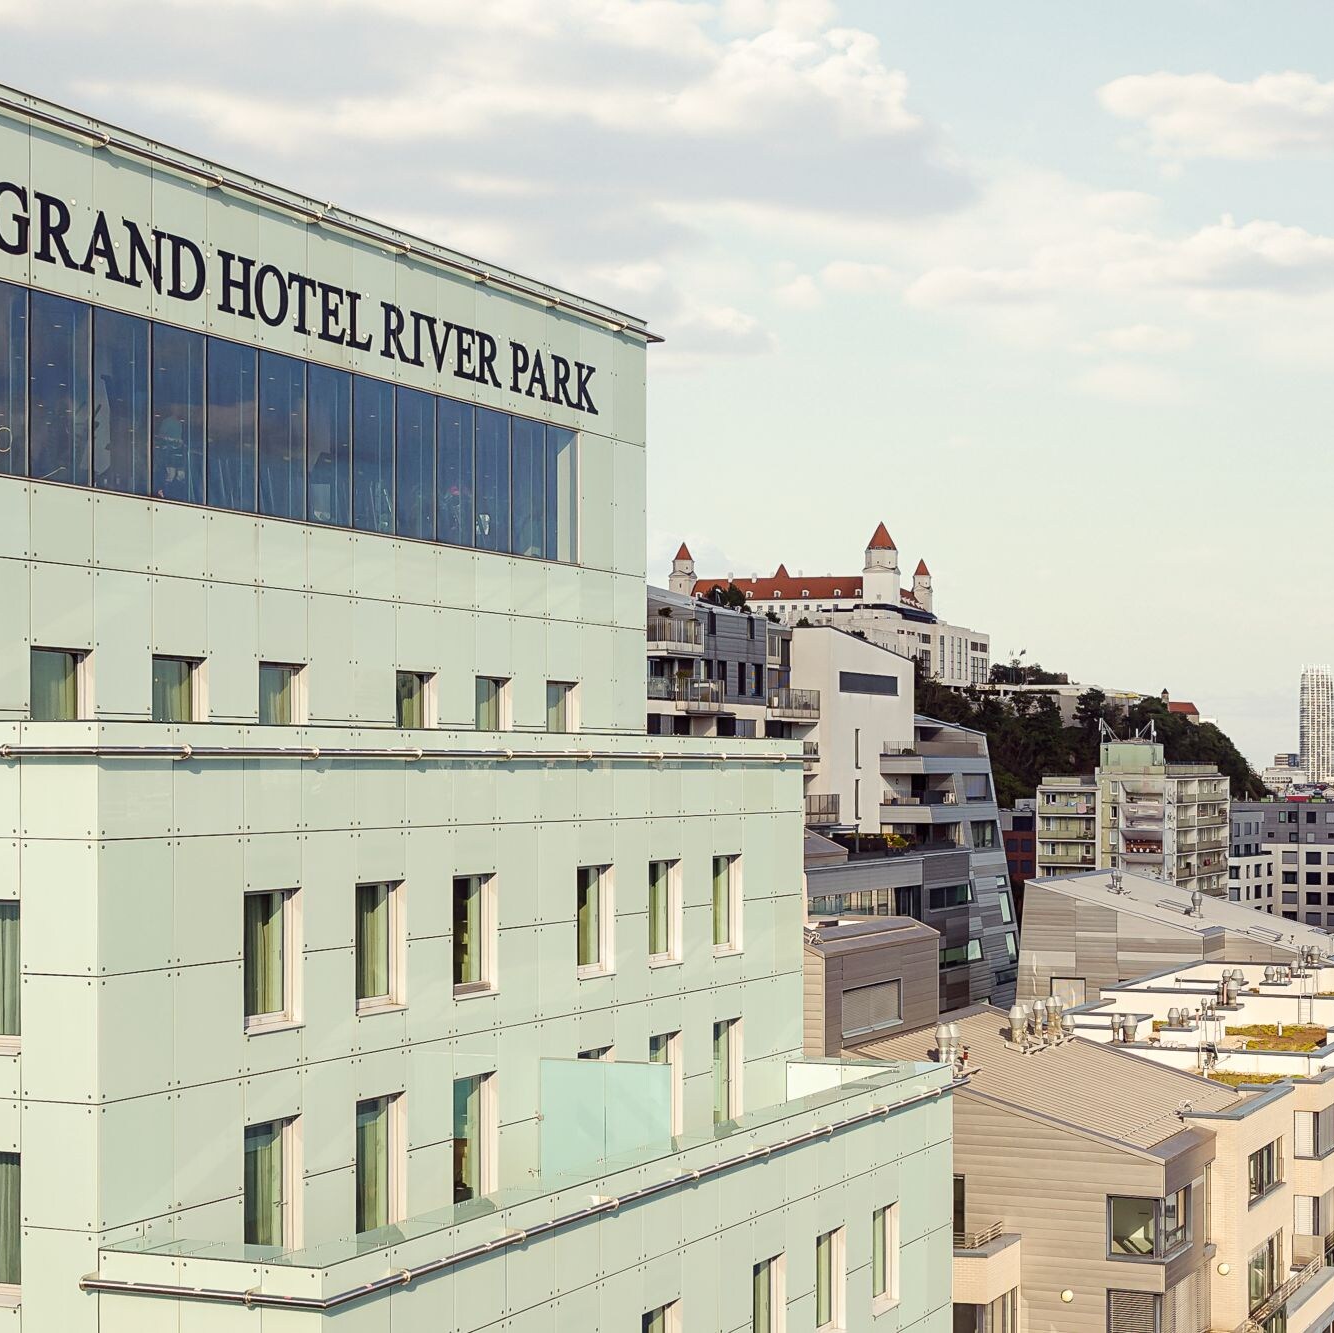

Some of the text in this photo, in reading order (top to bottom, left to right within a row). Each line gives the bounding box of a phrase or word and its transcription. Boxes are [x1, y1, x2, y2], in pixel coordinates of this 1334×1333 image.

[217, 249, 373, 352] HOTEL
[380, 300, 502, 389] RIVER
[510, 340, 599, 415] PARK
